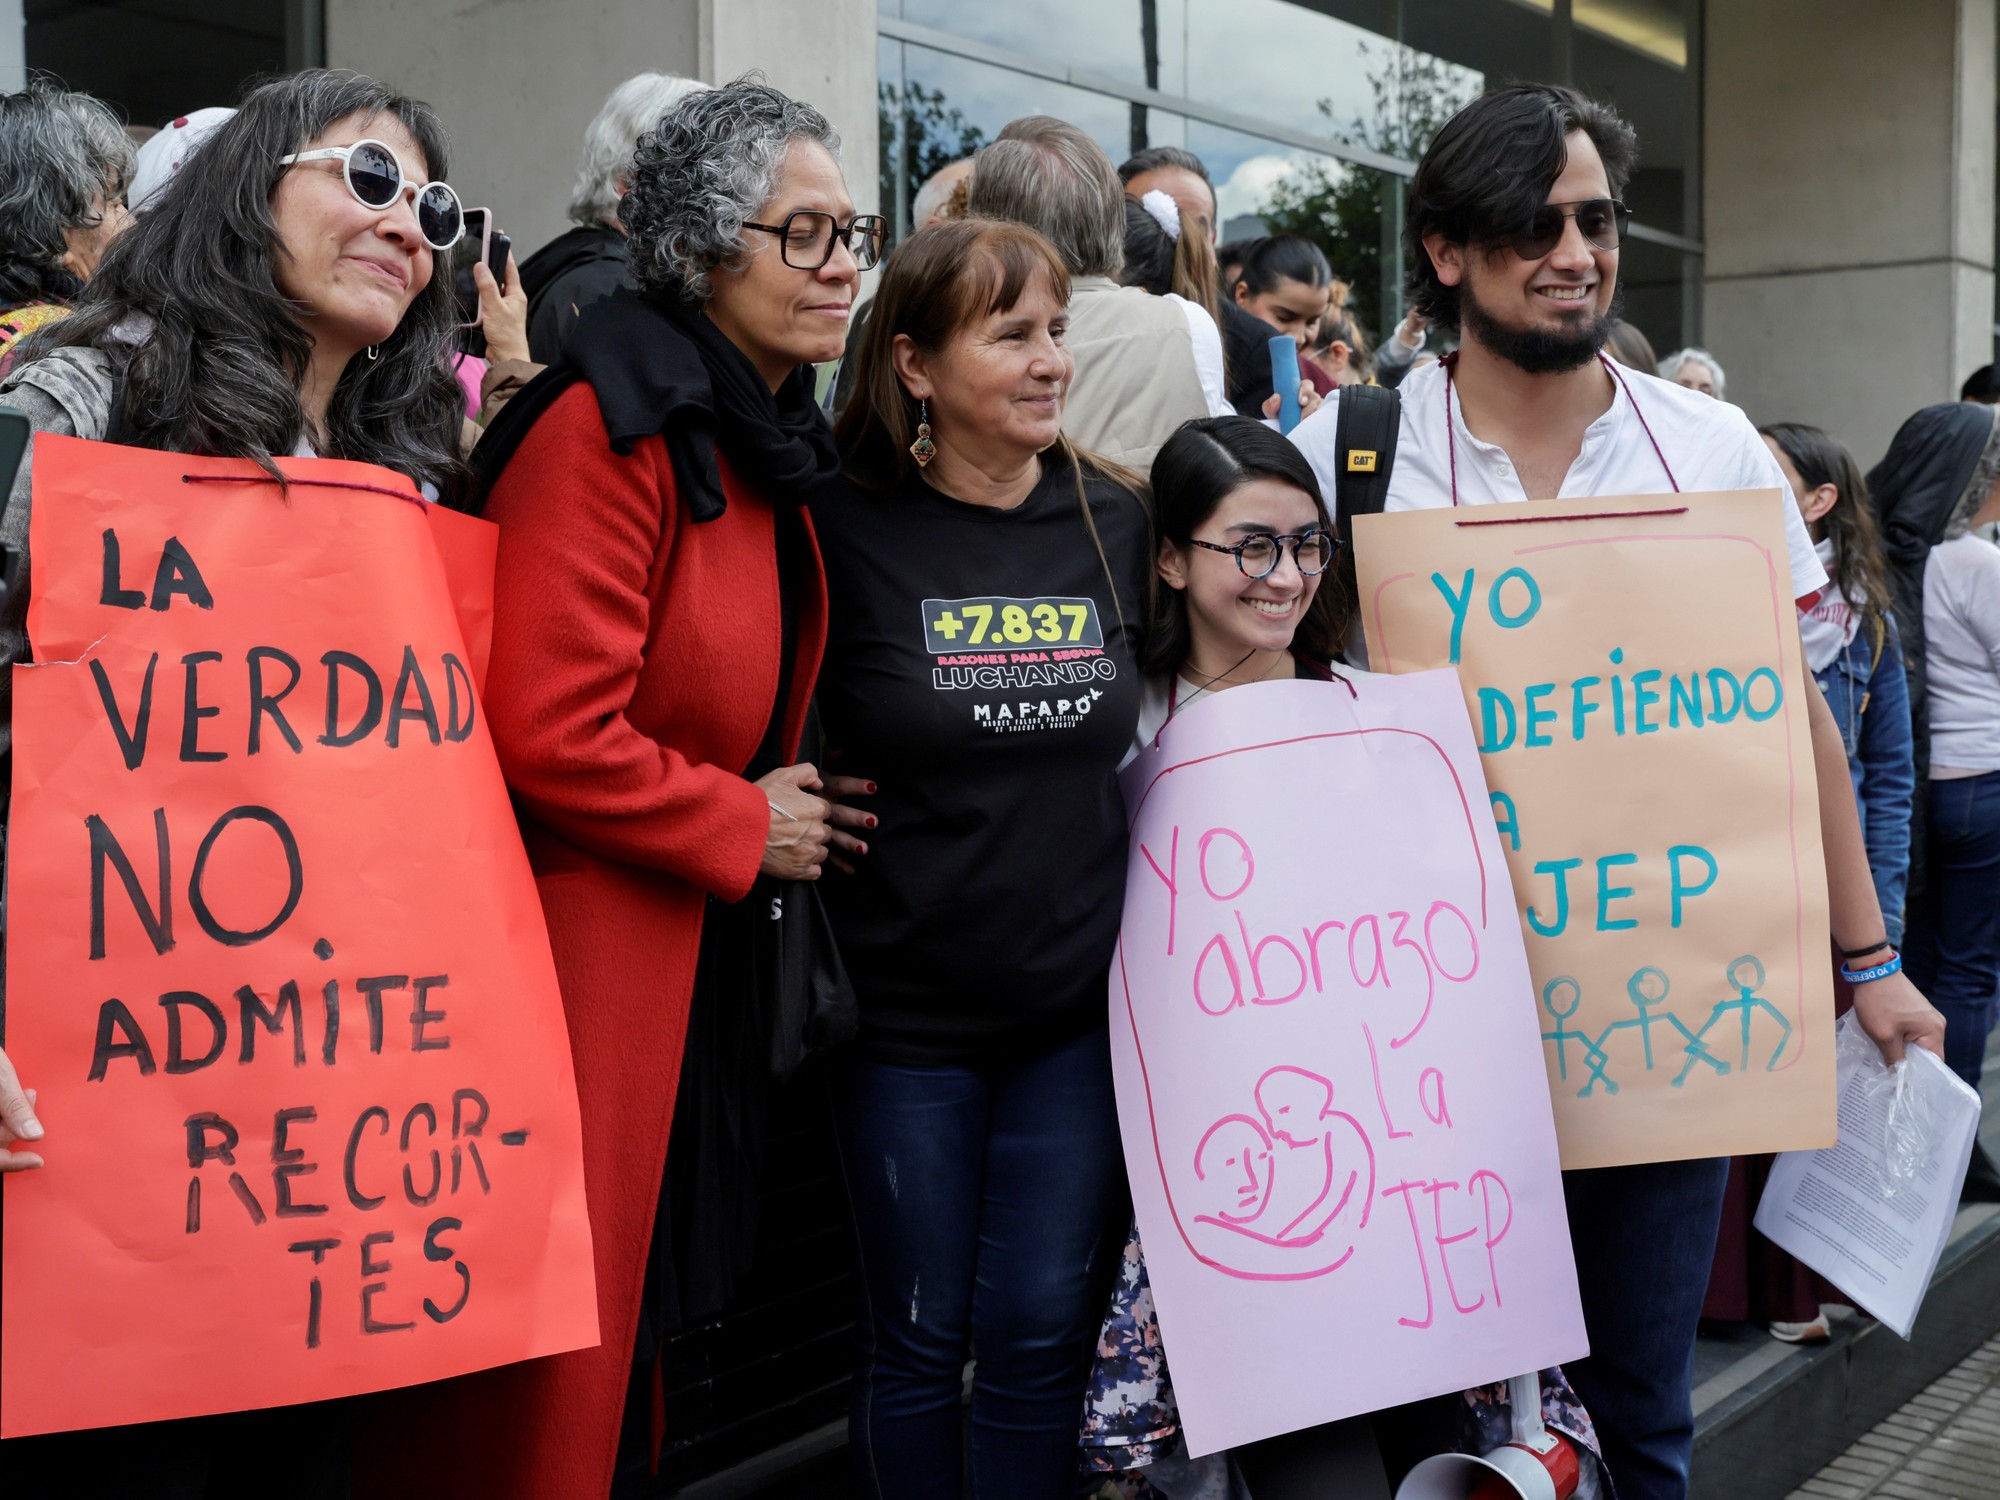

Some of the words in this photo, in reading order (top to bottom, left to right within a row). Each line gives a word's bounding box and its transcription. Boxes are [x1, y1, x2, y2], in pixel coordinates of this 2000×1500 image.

[1353, 455, 1369, 466] CAT
[99, 528, 214, 612] LA
[1430, 567, 1542, 665] YO
[933, 603, 1089, 645] +7.837
[937, 655, 1007, 665] RAZONES
[1011, 652, 1050, 663] PARA
[88, 645, 475, 772] VERDAD
[932, 658, 1117, 690] LUCHANDO
[1046, 715, 1083, 723] POSITIVOS
[1477, 646, 1784, 754] DEFIENDO
[1140, 825, 1256, 956] YO
[1526, 844, 1719, 938] JEP
[1193, 899, 1480, 1049] abrazo
[1876, 968, 1889, 976] YO
[287, 1216, 471, 1350] TES
[1381, 1169, 1514, 1329] JEP
